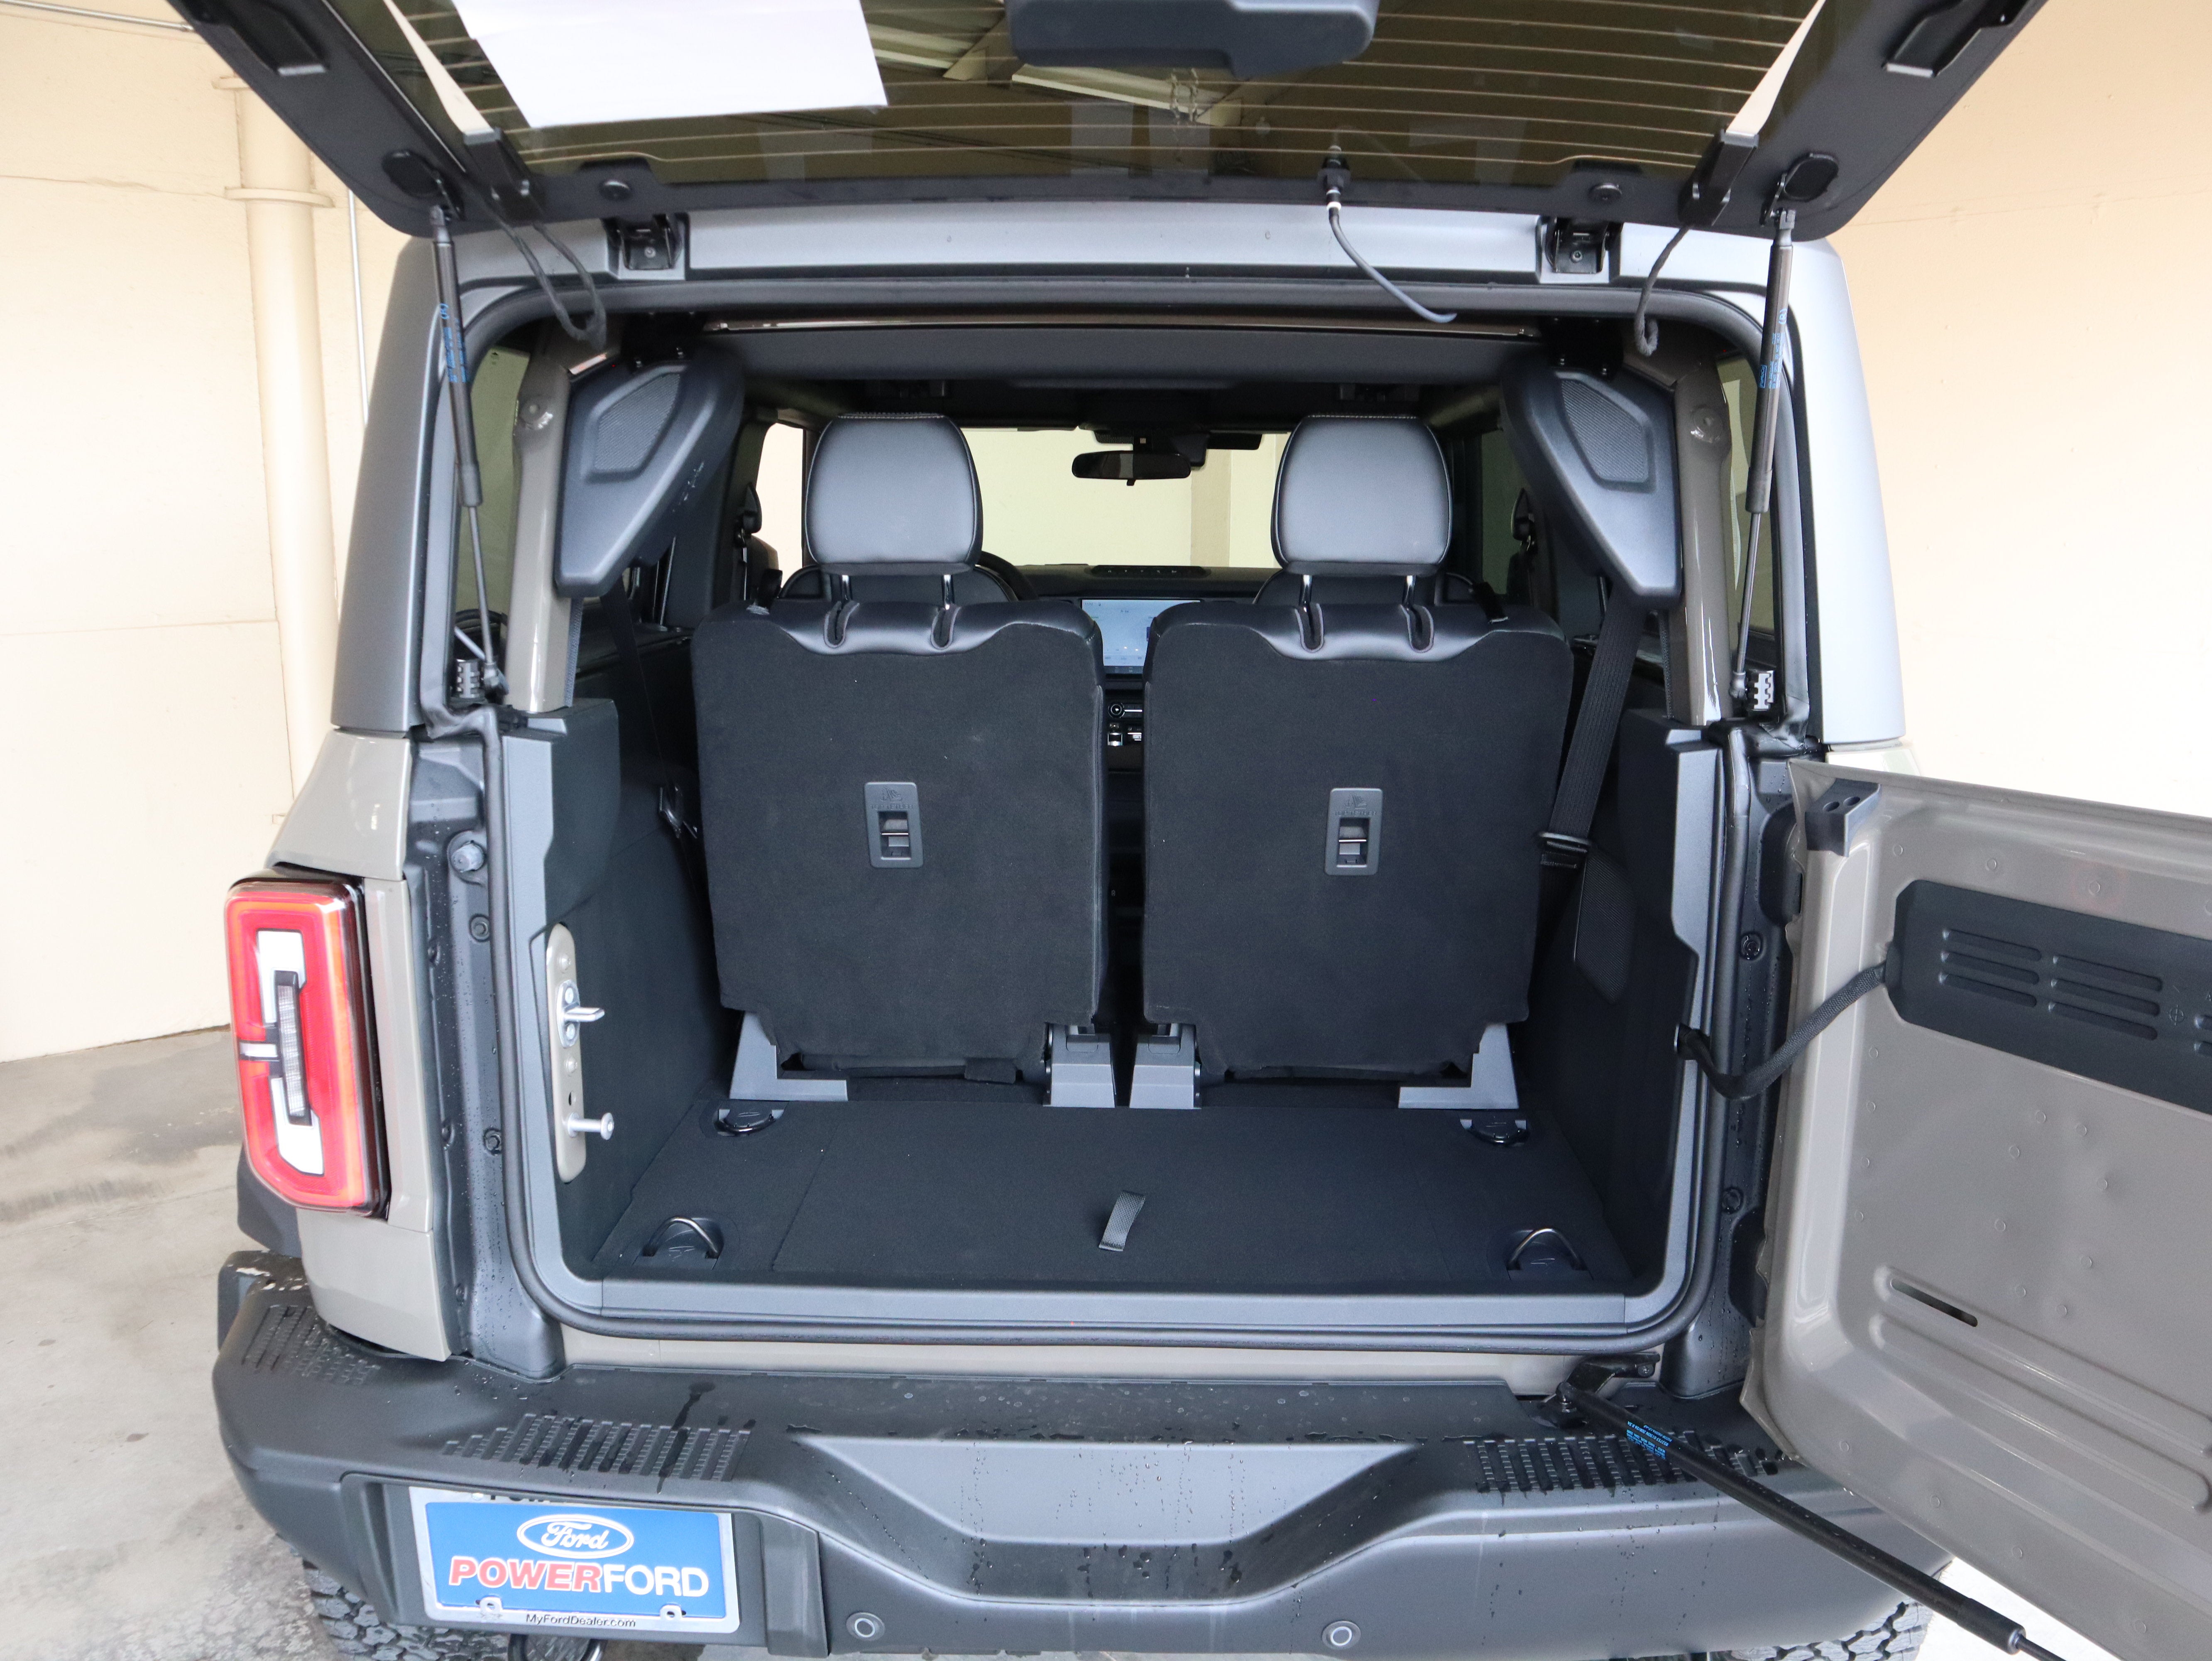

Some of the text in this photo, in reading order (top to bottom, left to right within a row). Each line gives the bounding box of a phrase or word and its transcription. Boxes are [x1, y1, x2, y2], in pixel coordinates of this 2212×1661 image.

[541, 1521, 609, 1550] Ford
[449, 1556, 709, 1597] POWERFORD
[526, 1614, 636, 1627] MyFordDealer.com
